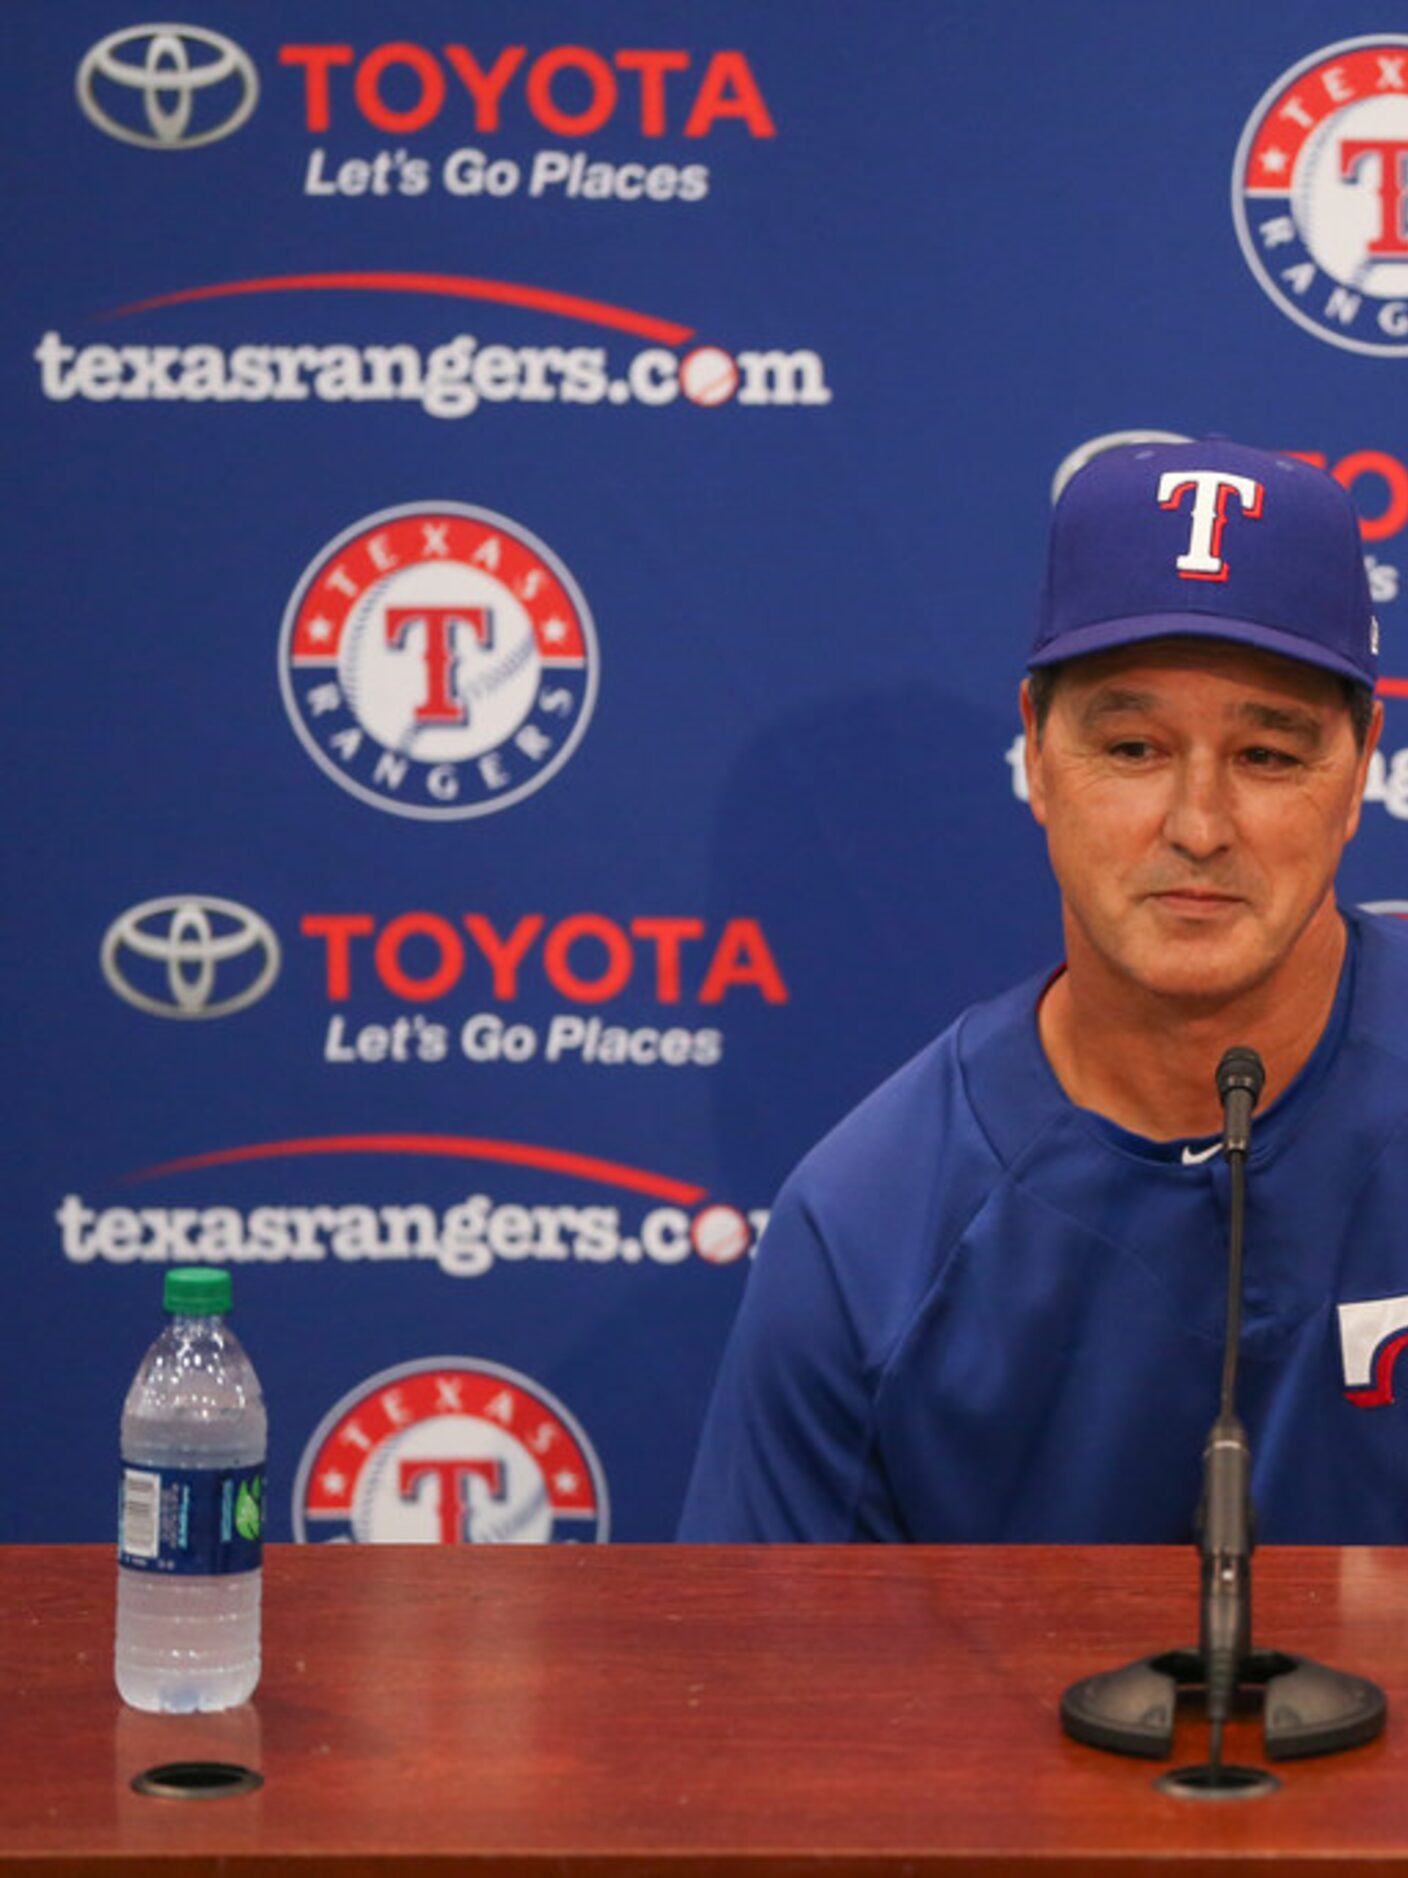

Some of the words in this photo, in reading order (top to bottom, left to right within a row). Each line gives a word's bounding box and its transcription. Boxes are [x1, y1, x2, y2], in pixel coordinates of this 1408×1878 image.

[280, 43, 775, 137] TOYOTA
[306, 150, 428, 195] Let's
[444, 149, 519, 195] Go
[530, 150, 707, 200] Places
[35, 331, 832, 419] texasrangers.com
[324, 522, 551, 601] TEXAS
[1157, 470, 1265, 582] T
[384, 606, 494, 728] T
[306, 683, 573, 801] RANGERS
[302, 913, 787, 1003] TOYOTA
[326, 1016, 446, 1061] Let's
[462, 1014, 536, 1061] Go
[546, 1015, 721, 1064] Places
[57, 1195, 771, 1276] texasrangers.co
[339, 1377, 560, 1454] TEXAS
